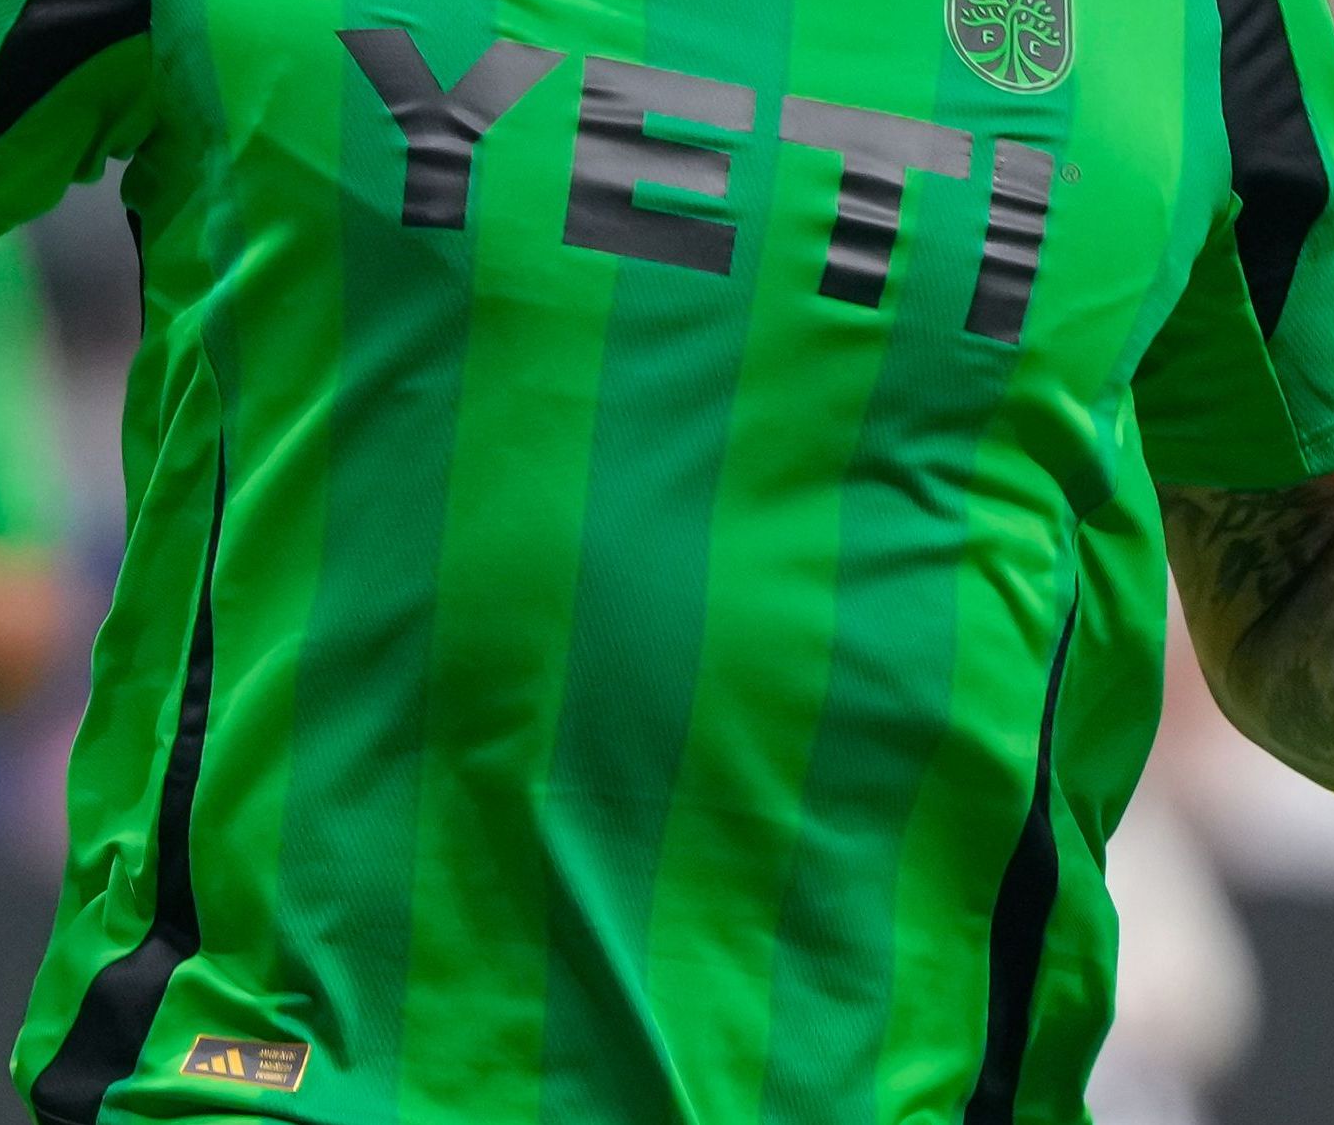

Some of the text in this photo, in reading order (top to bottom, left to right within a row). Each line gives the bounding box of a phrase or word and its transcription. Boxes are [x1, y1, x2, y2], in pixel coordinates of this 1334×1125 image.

[981, 29, 1042, 58] F C
[334, 27, 1054, 345] YETI
